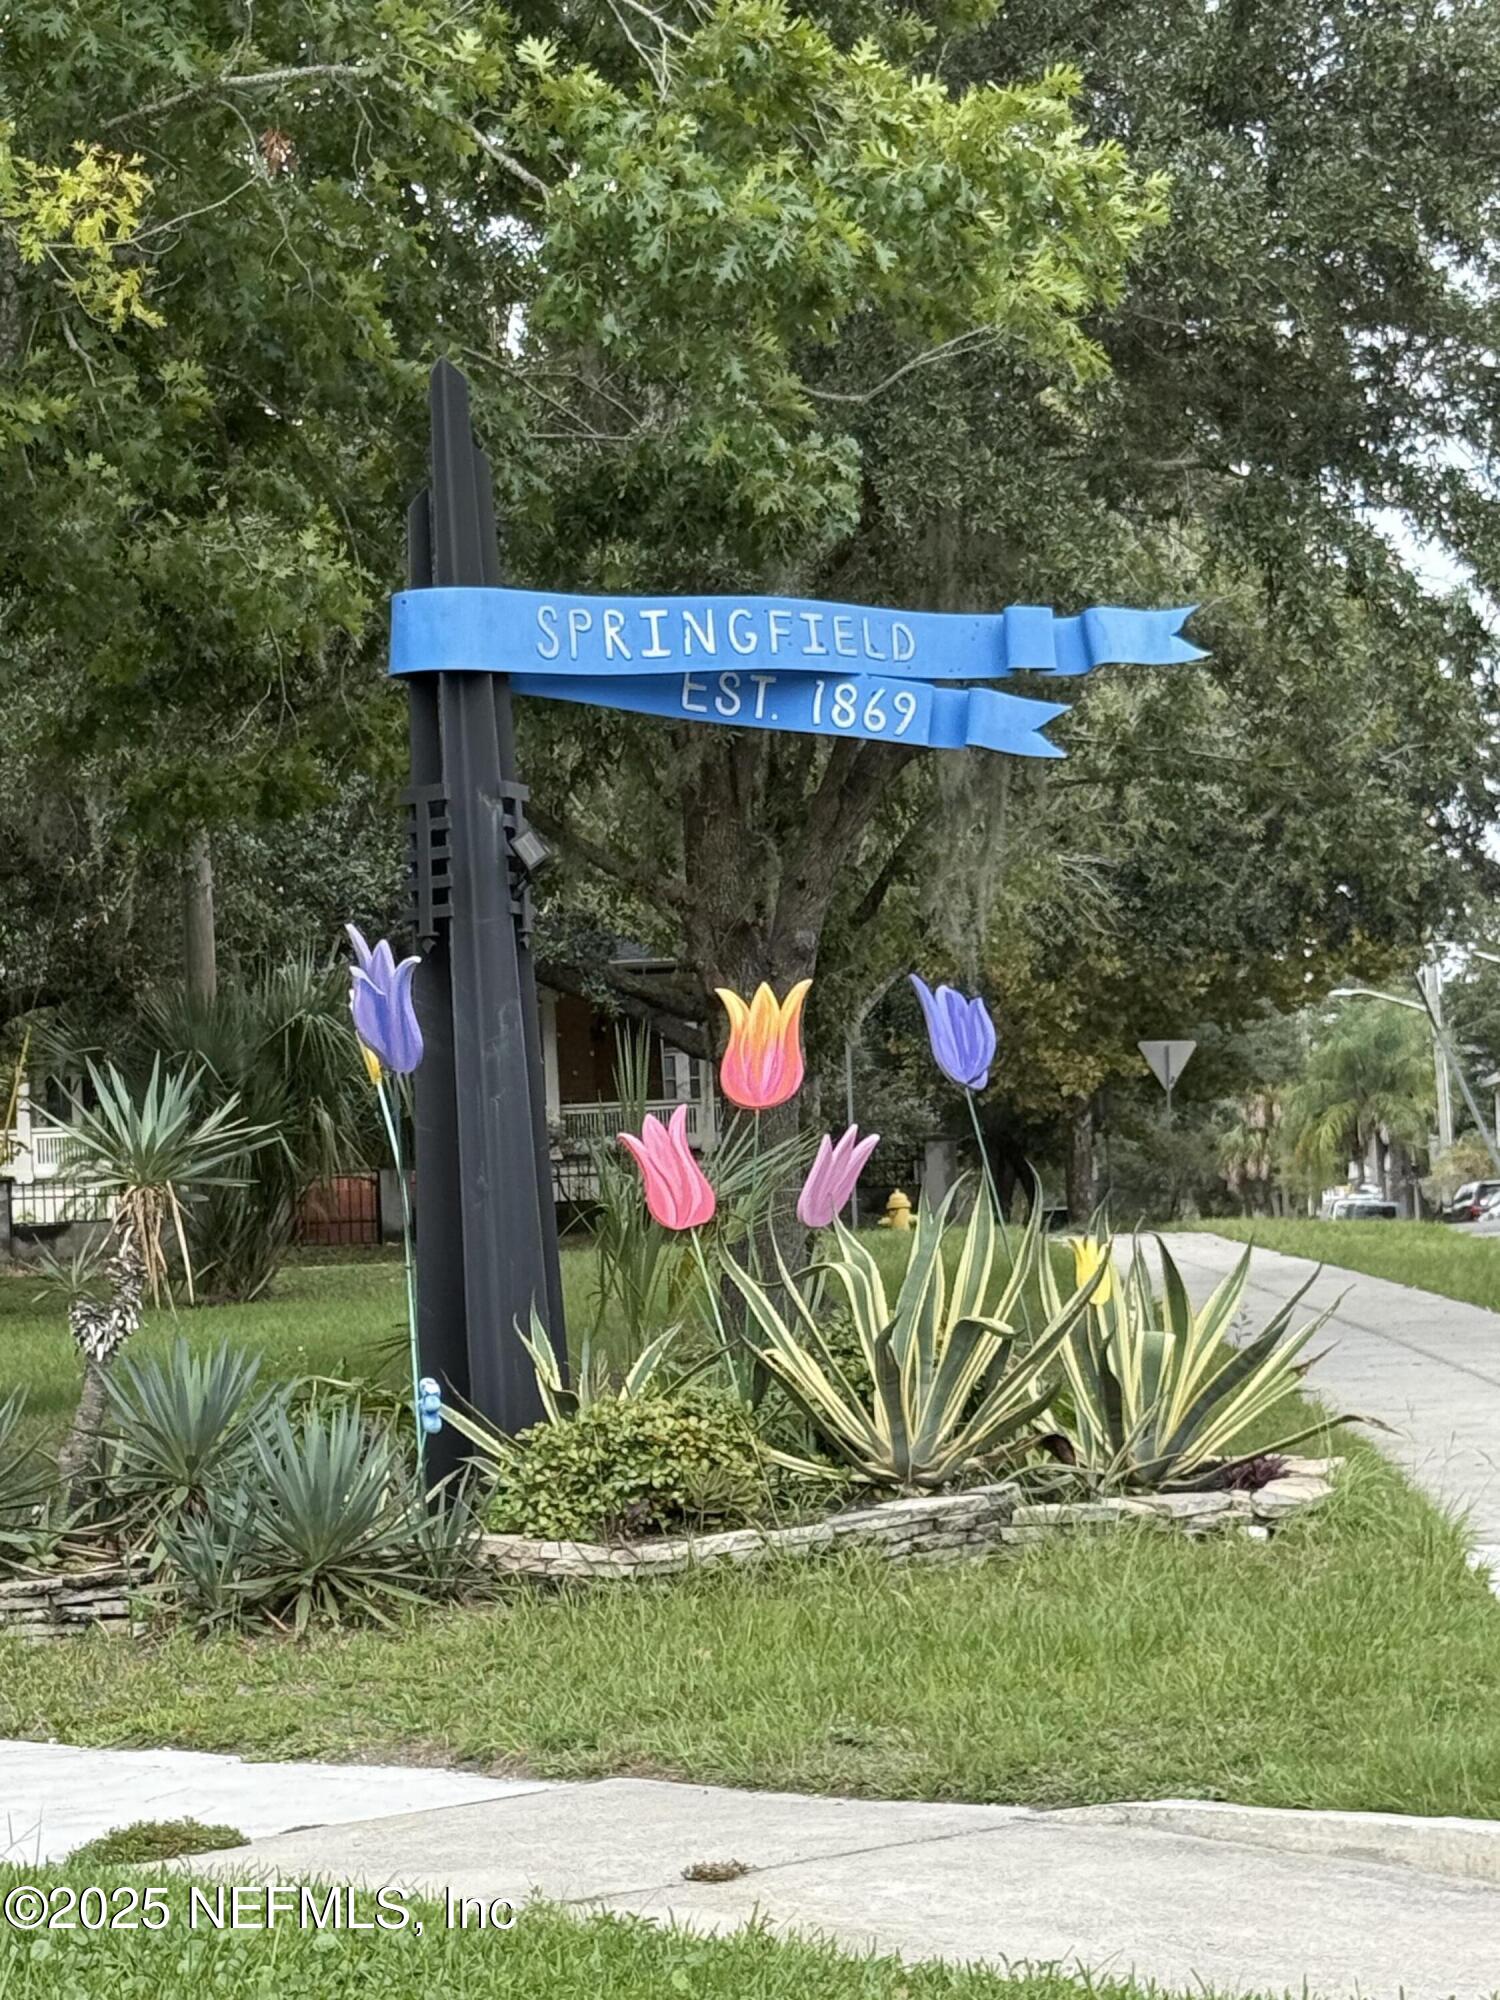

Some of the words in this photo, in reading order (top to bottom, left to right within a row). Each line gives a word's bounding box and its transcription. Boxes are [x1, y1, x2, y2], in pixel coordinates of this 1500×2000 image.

[535, 605, 917, 662] SPRINGFIELD
[680, 672, 779, 721] EST.
[811, 679, 918, 735] 1869
